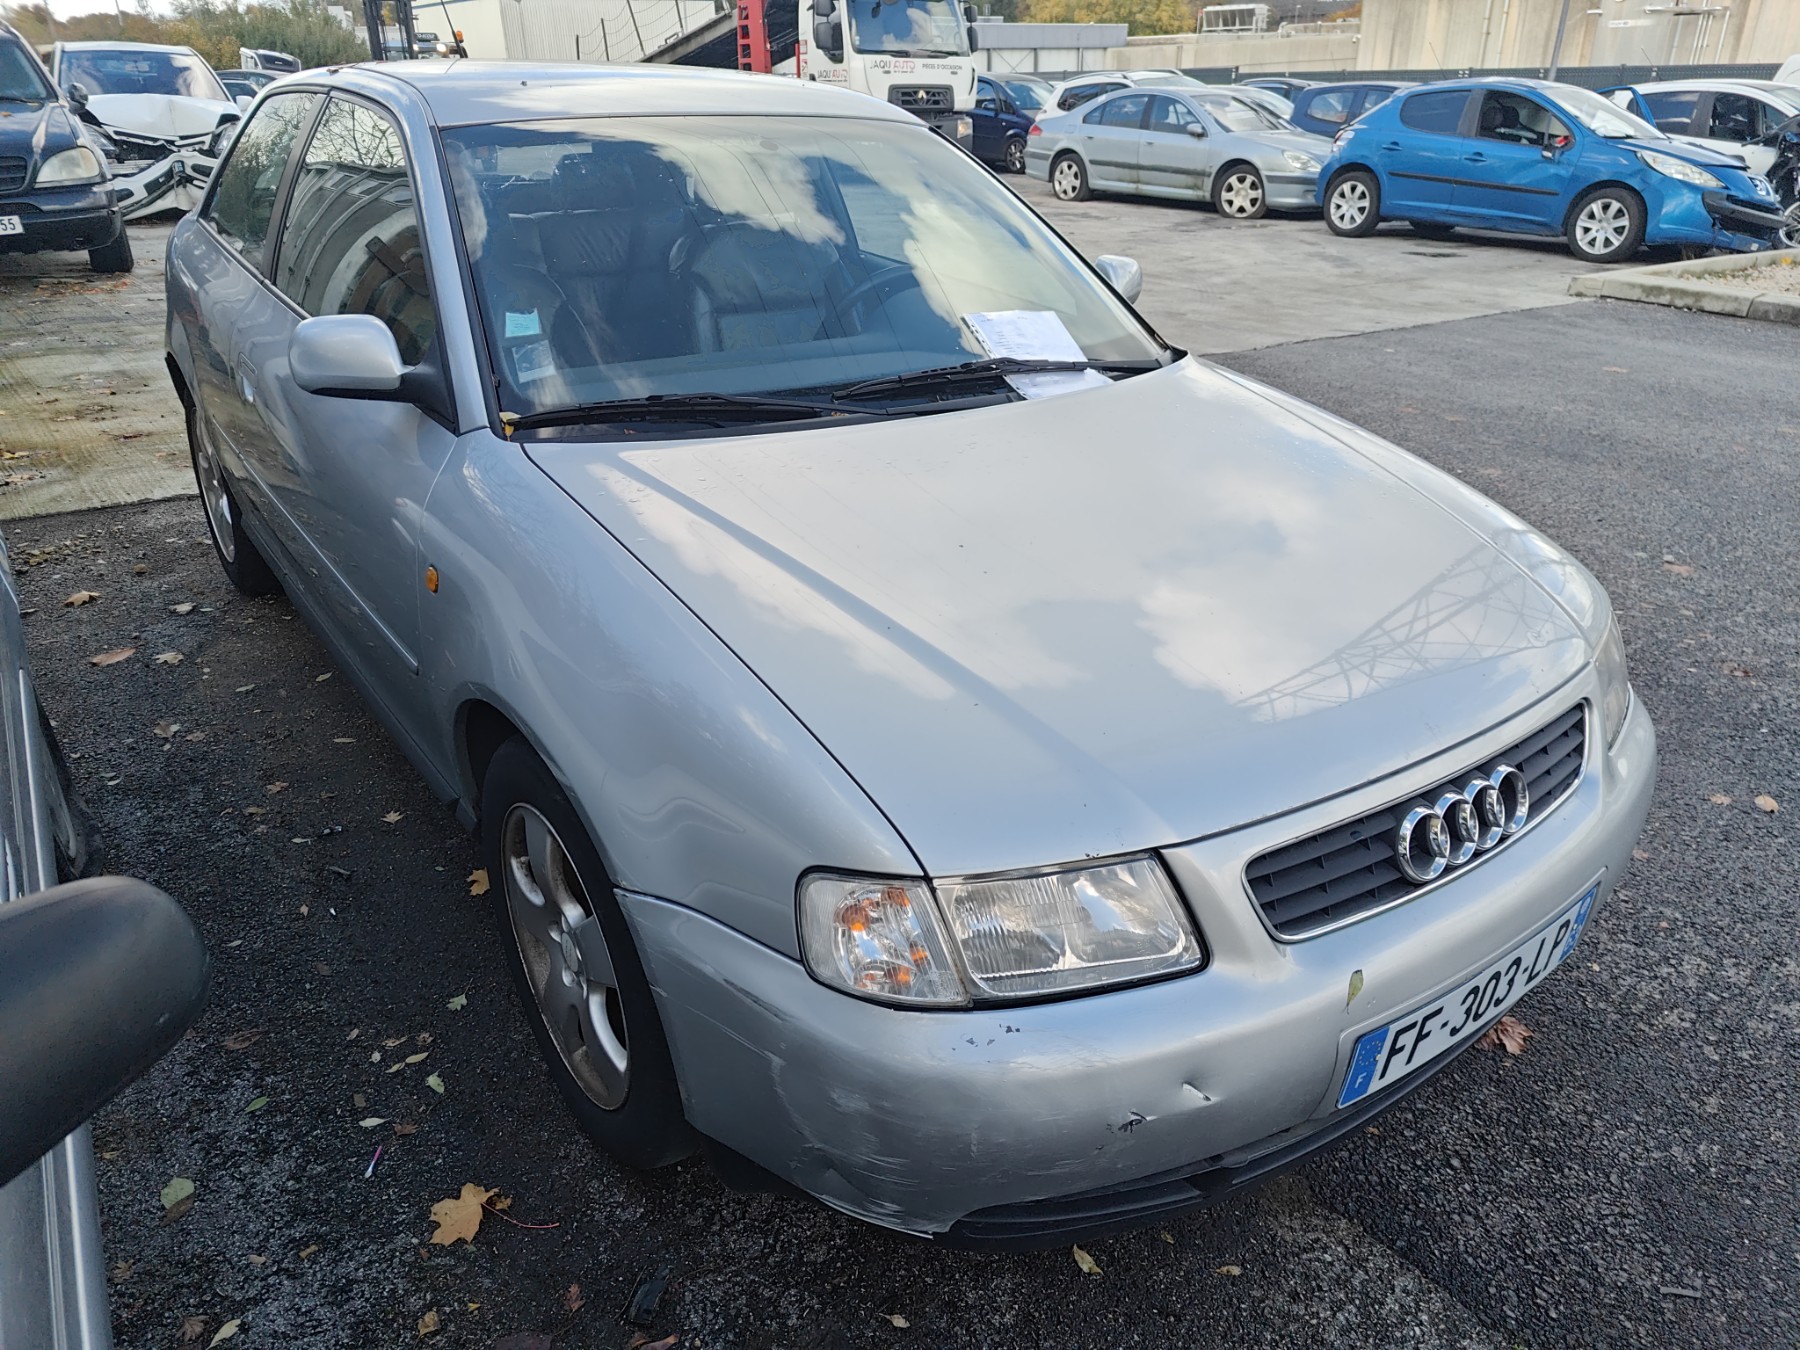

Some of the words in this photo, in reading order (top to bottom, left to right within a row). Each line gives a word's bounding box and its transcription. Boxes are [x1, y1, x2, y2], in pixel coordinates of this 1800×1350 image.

[0, 218, 16, 231] 55
[1378, 919, 1571, 1081] FF-303-LP
[1354, 1072, 1367, 1089] F
